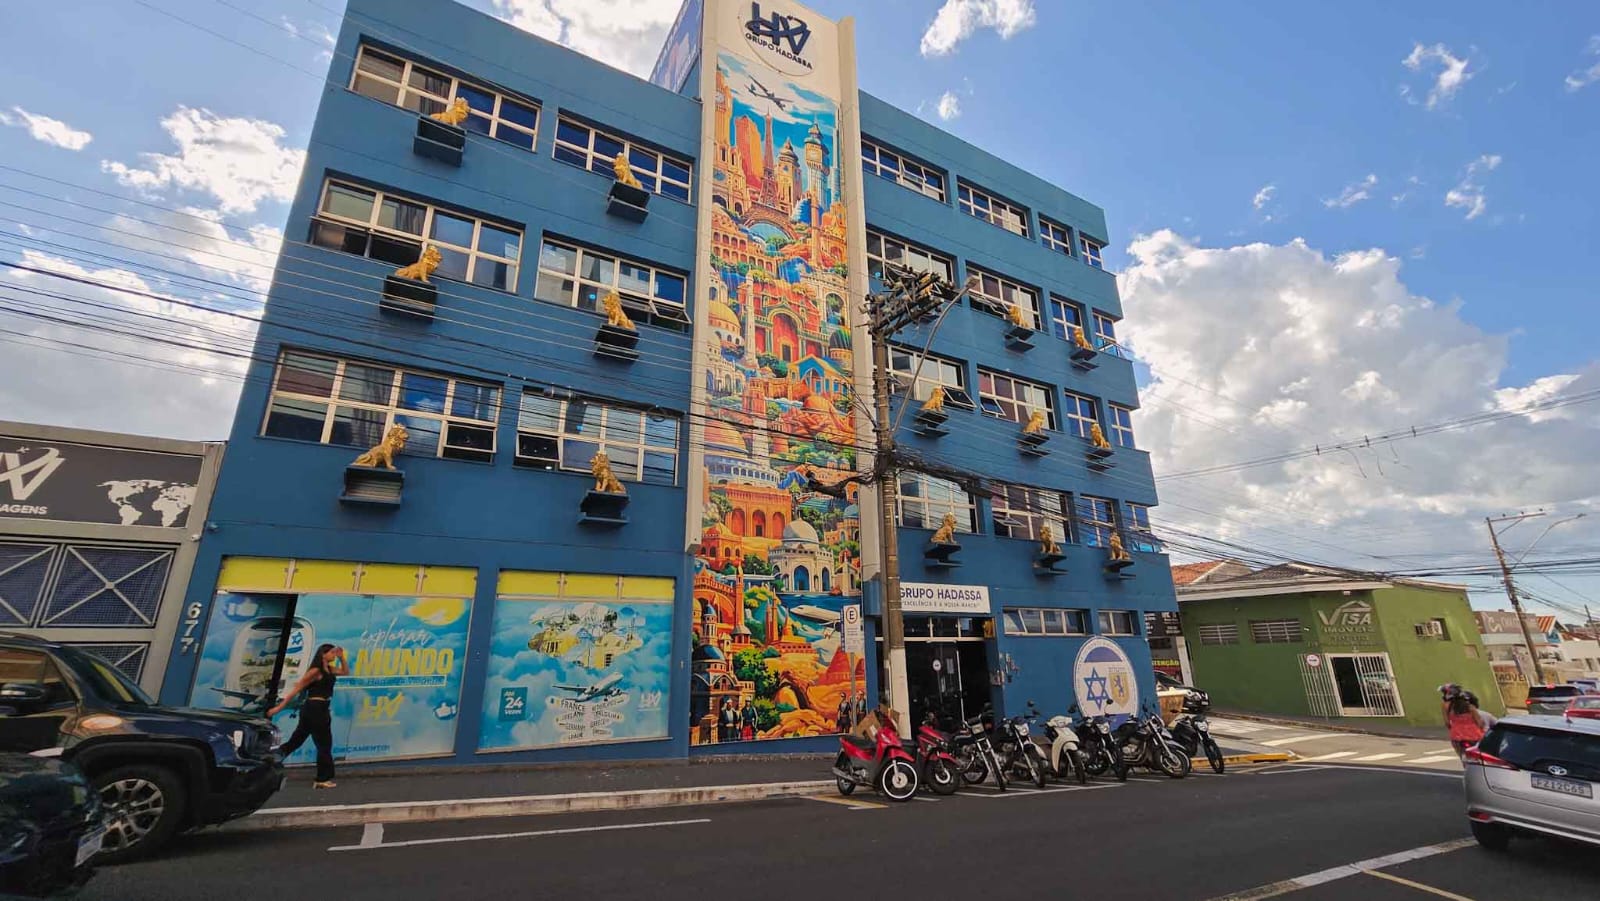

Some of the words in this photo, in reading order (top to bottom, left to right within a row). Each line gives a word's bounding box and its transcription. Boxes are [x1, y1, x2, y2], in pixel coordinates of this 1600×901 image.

[745, 33, 775, 51] GRUPO
[776, 47, 812, 69] HADASSA
[0, 504, 48, 515] AGENS
[900, 587, 934, 599] GRUPO
[937, 588, 982, 600] HADASSA
[849, 610, 855, 620] E
[1318, 608, 1371, 625] VISA
[354, 647, 454, 676] MUNDO
[505, 697, 524, 708] 24
[561, 699, 585, 712] FRANCE
